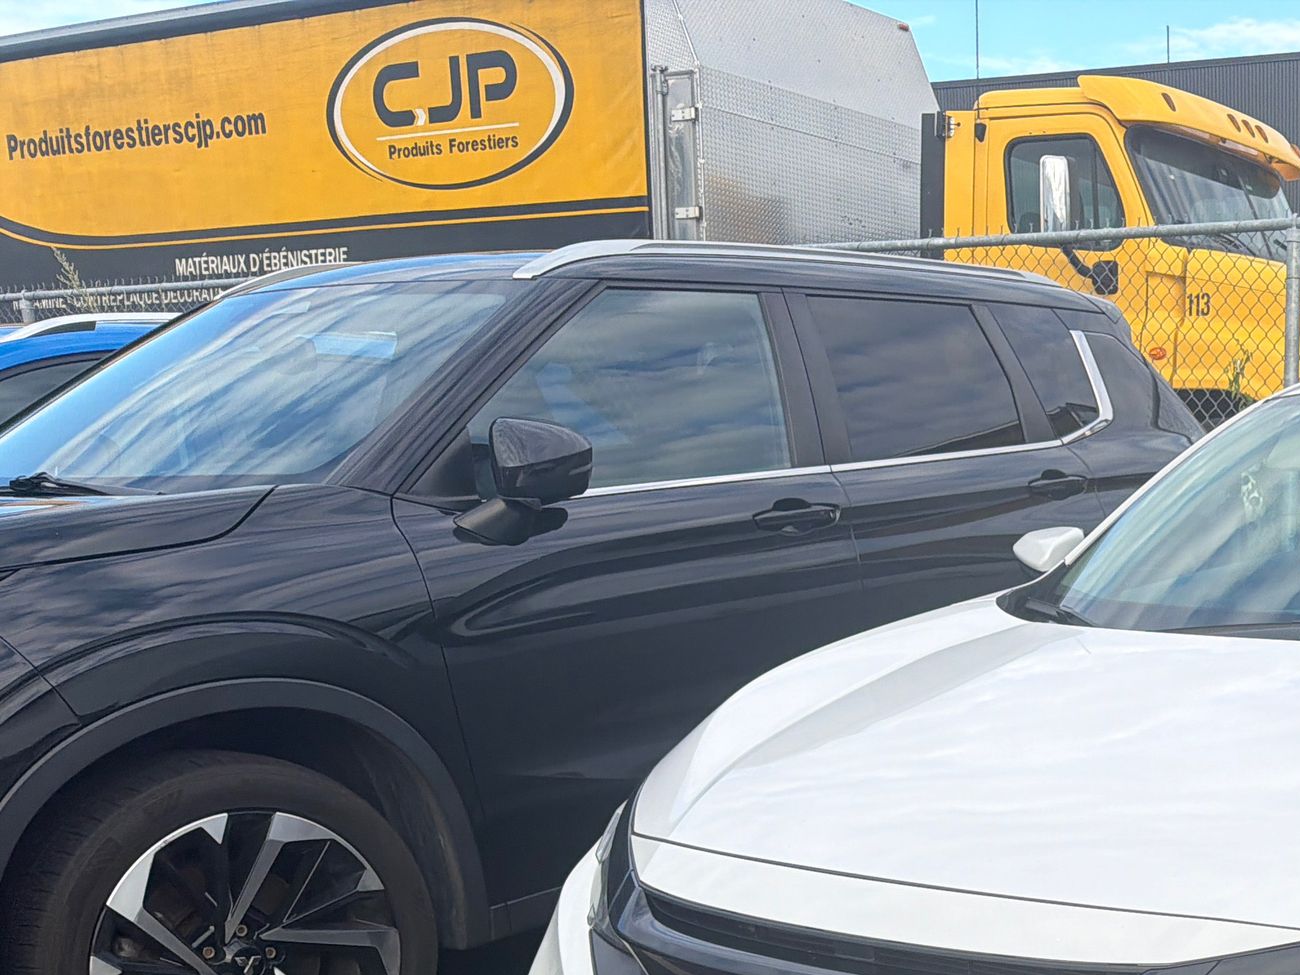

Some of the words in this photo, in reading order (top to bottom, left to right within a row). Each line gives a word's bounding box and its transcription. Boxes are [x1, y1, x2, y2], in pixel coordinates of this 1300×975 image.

[373, 50, 517, 128] CJP
[6, 111, 267, 160] Produitsforestierscjp.com
[389, 141, 443, 160] Produits
[449, 134, 519, 154] Forestiers
[175, 252, 247, 276] MATÉRIAUX
[1187, 292, 1211, 317] 113
